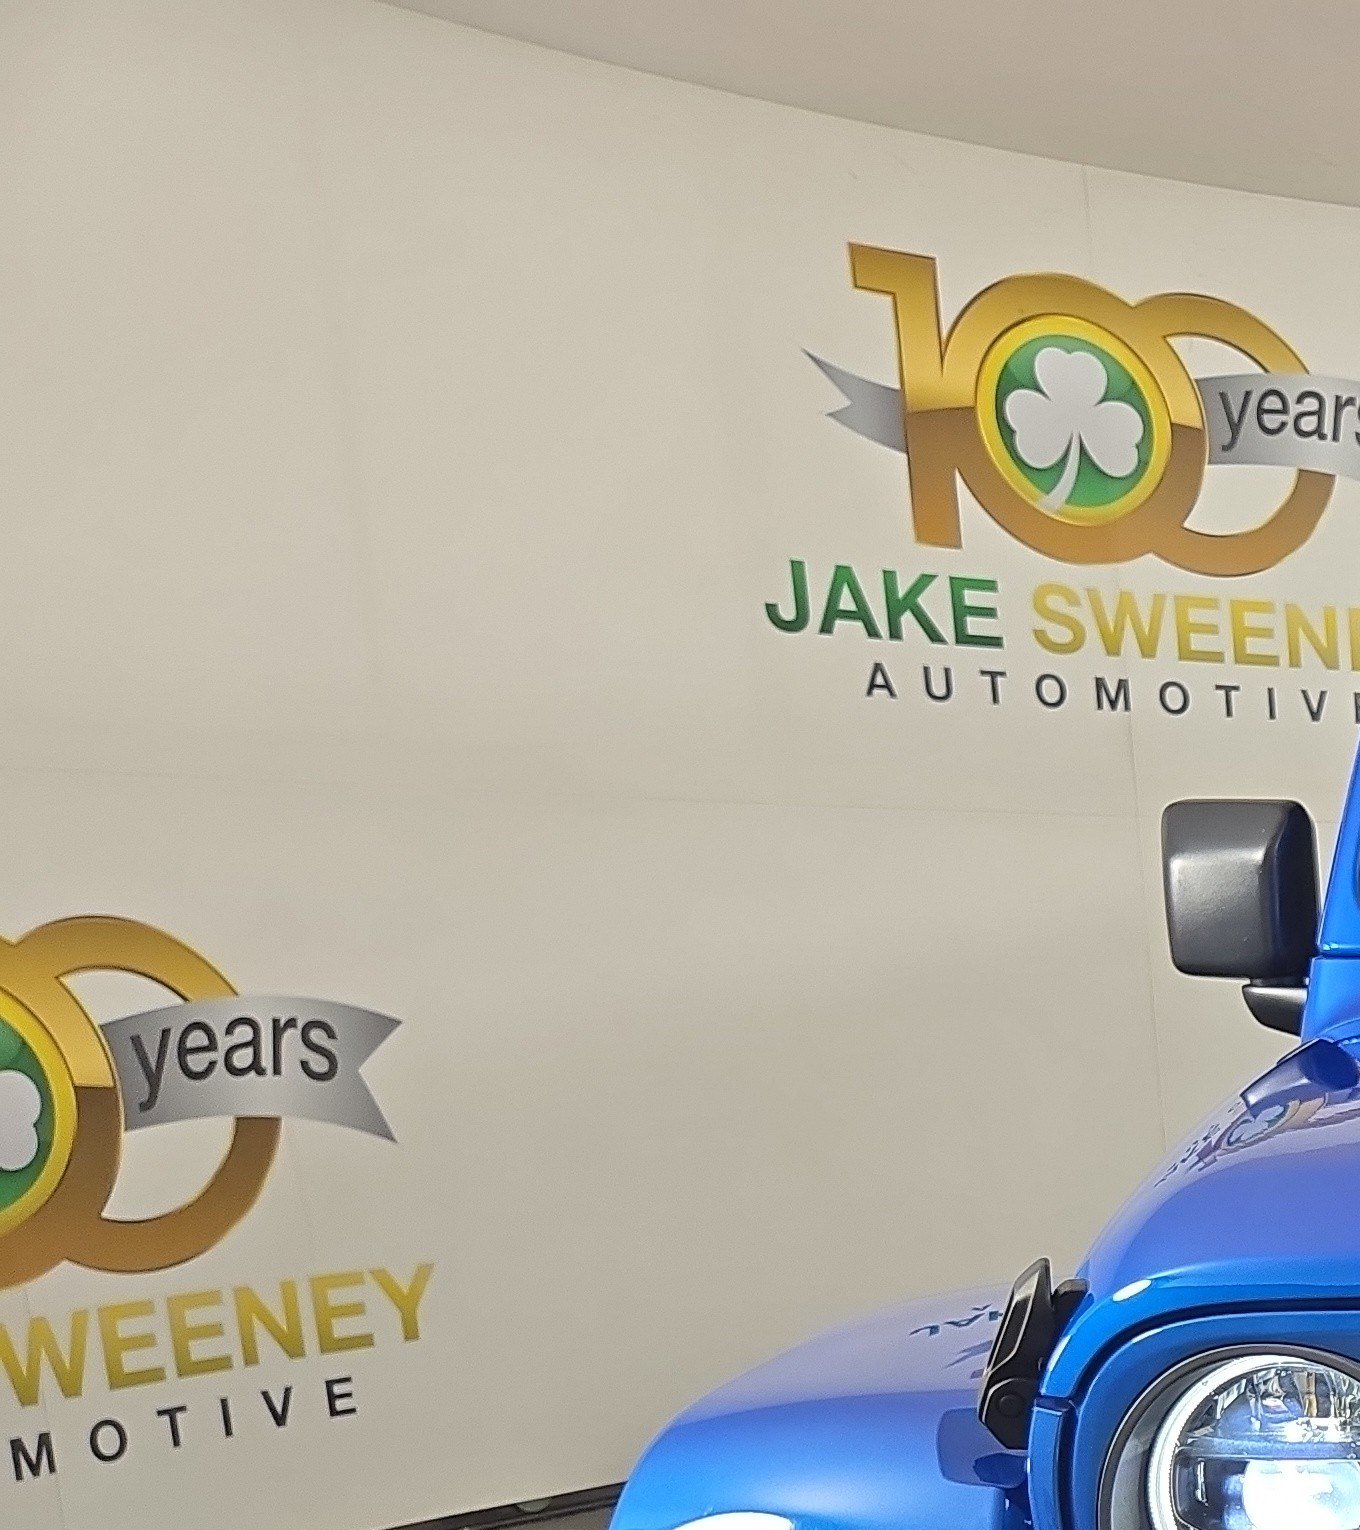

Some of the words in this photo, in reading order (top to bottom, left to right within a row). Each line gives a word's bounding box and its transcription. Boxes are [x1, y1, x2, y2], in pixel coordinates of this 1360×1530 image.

[848, 242, 1336, 578] 100
[764, 559, 1005, 649] JAKE
[130, 1015, 339, 1115] years
[9, 1376, 357, 1482] MOTIVE
